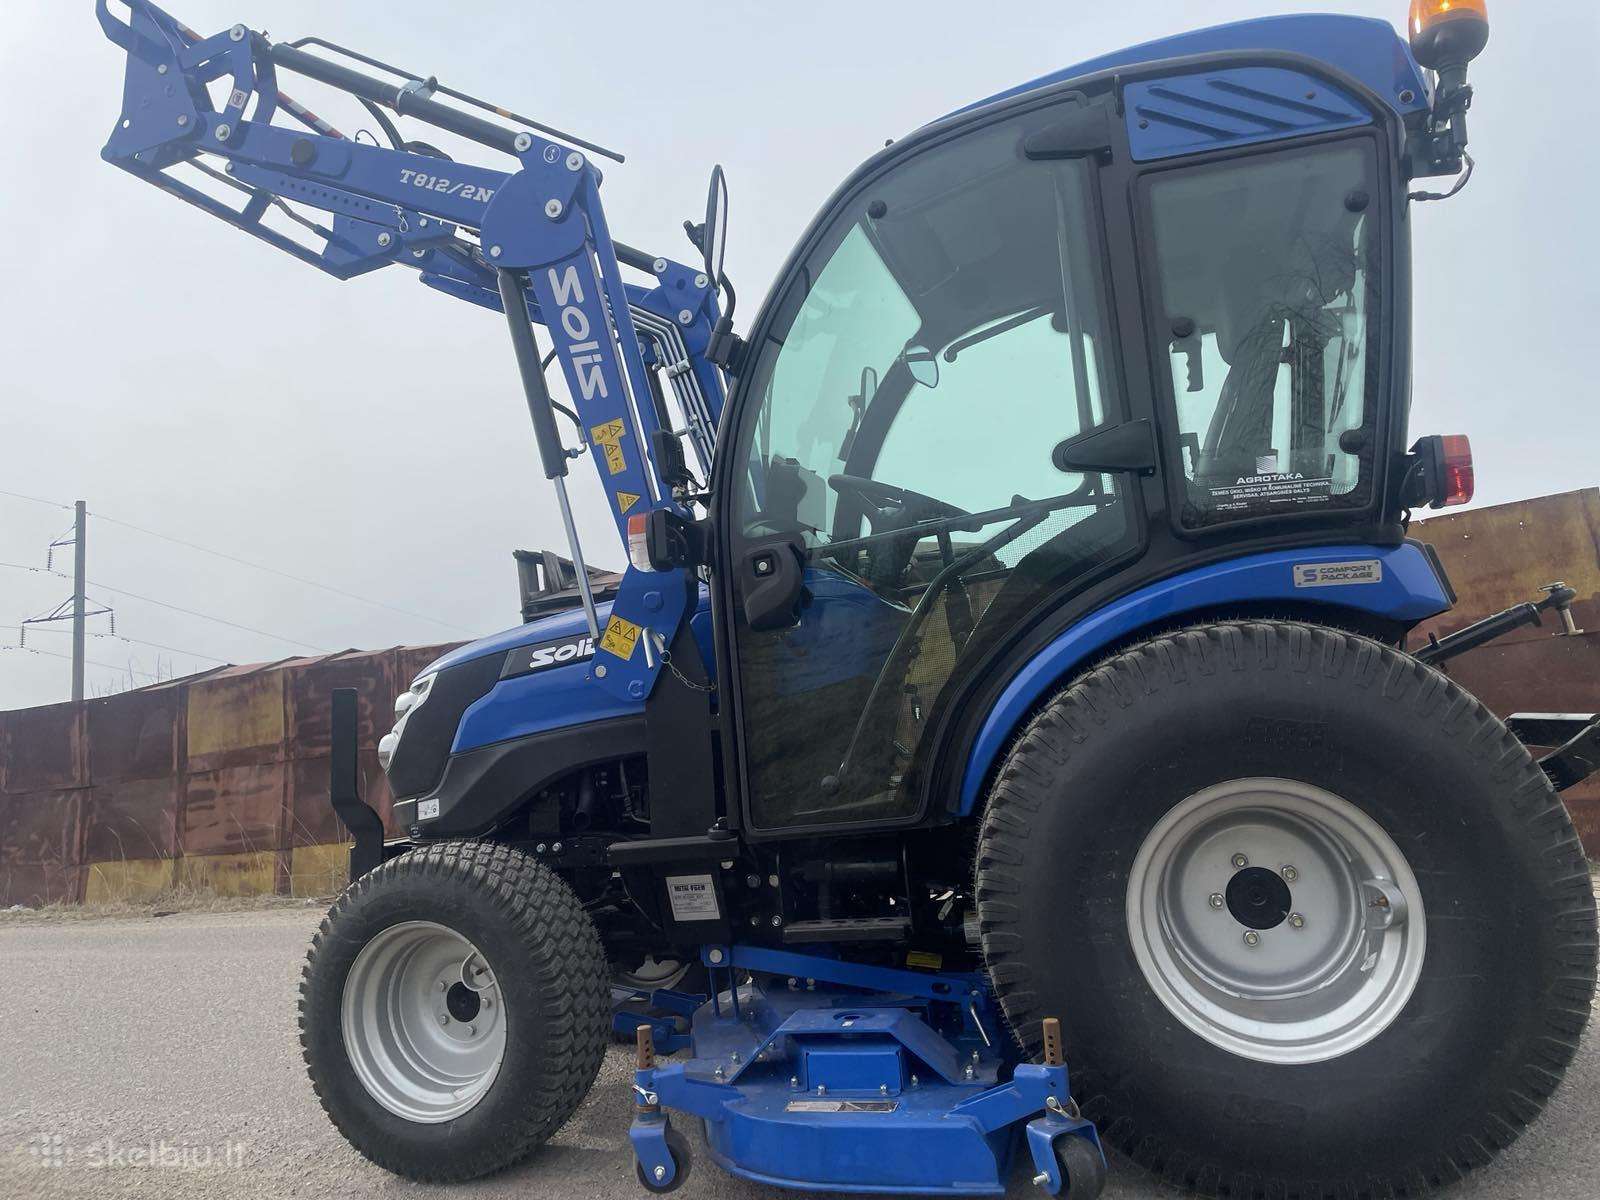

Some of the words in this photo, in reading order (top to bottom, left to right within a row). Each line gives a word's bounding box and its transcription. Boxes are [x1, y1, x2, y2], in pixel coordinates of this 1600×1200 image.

[400, 169, 495, 202] T812/2N
[1236, 472, 1304, 484] AGROTAKA
[1320, 564, 1373, 574] COMFORT
[1321, 571, 1373, 581] PACKAGE
